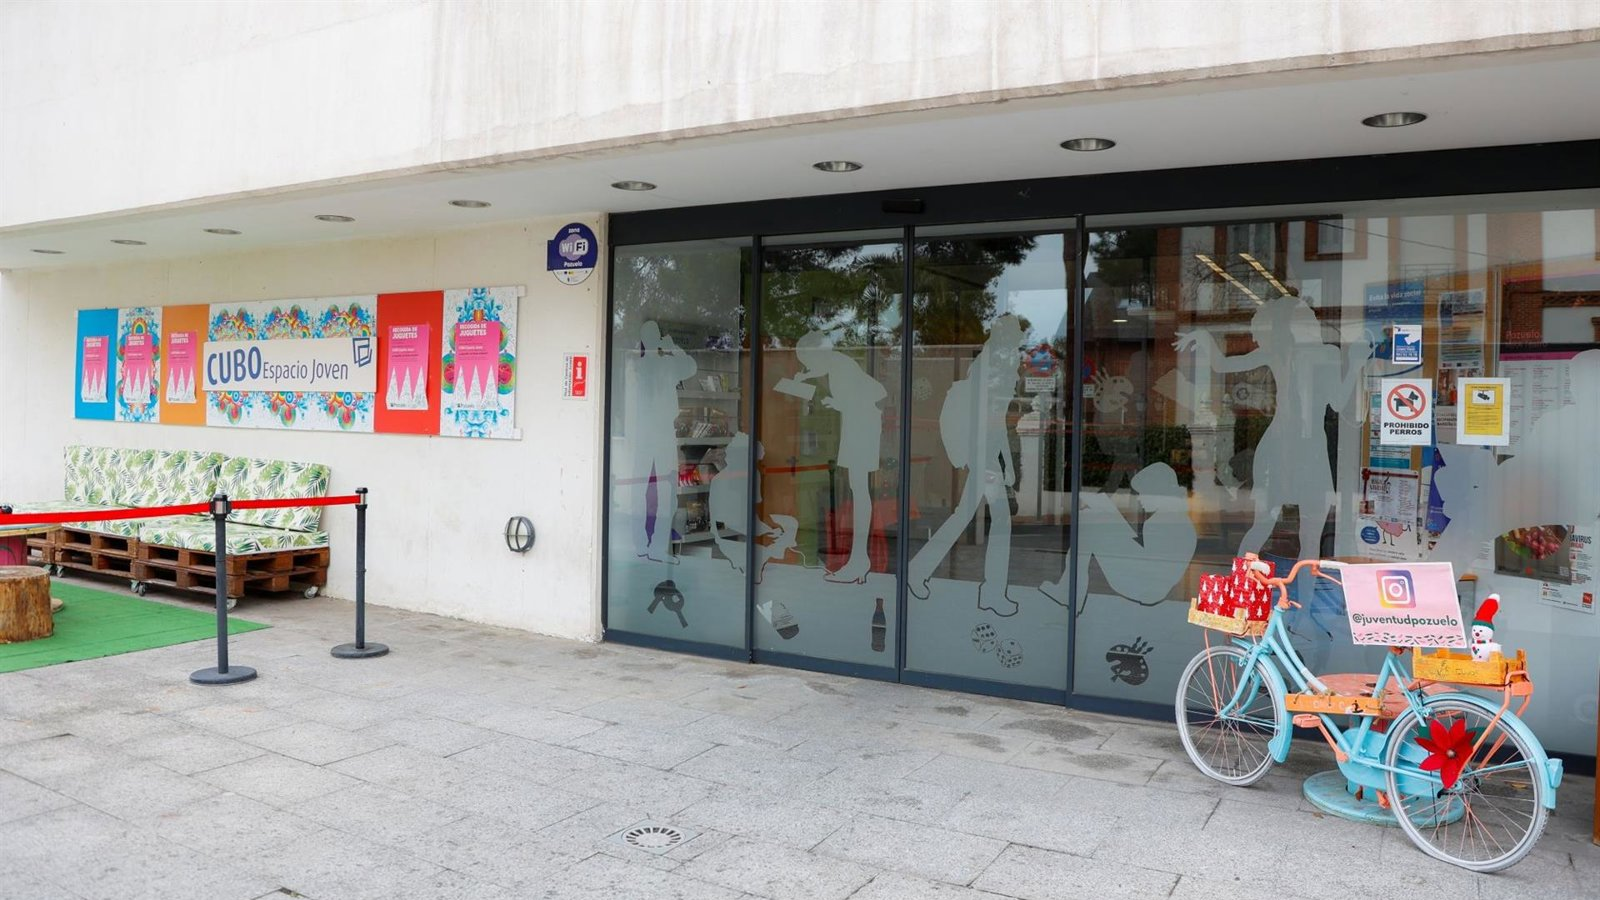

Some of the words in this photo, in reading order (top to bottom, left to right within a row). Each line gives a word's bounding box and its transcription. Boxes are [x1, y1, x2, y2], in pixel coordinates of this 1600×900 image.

[392, 332, 418, 340] JUGUETES
[459, 329, 487, 337] JUGUETES
[207, 346, 262, 385] CUBO
[263, 361, 308, 384] Espacio
[310, 359, 348, 384] Joven
[1352, 613, 1458, 627] @juventudpozuelo
